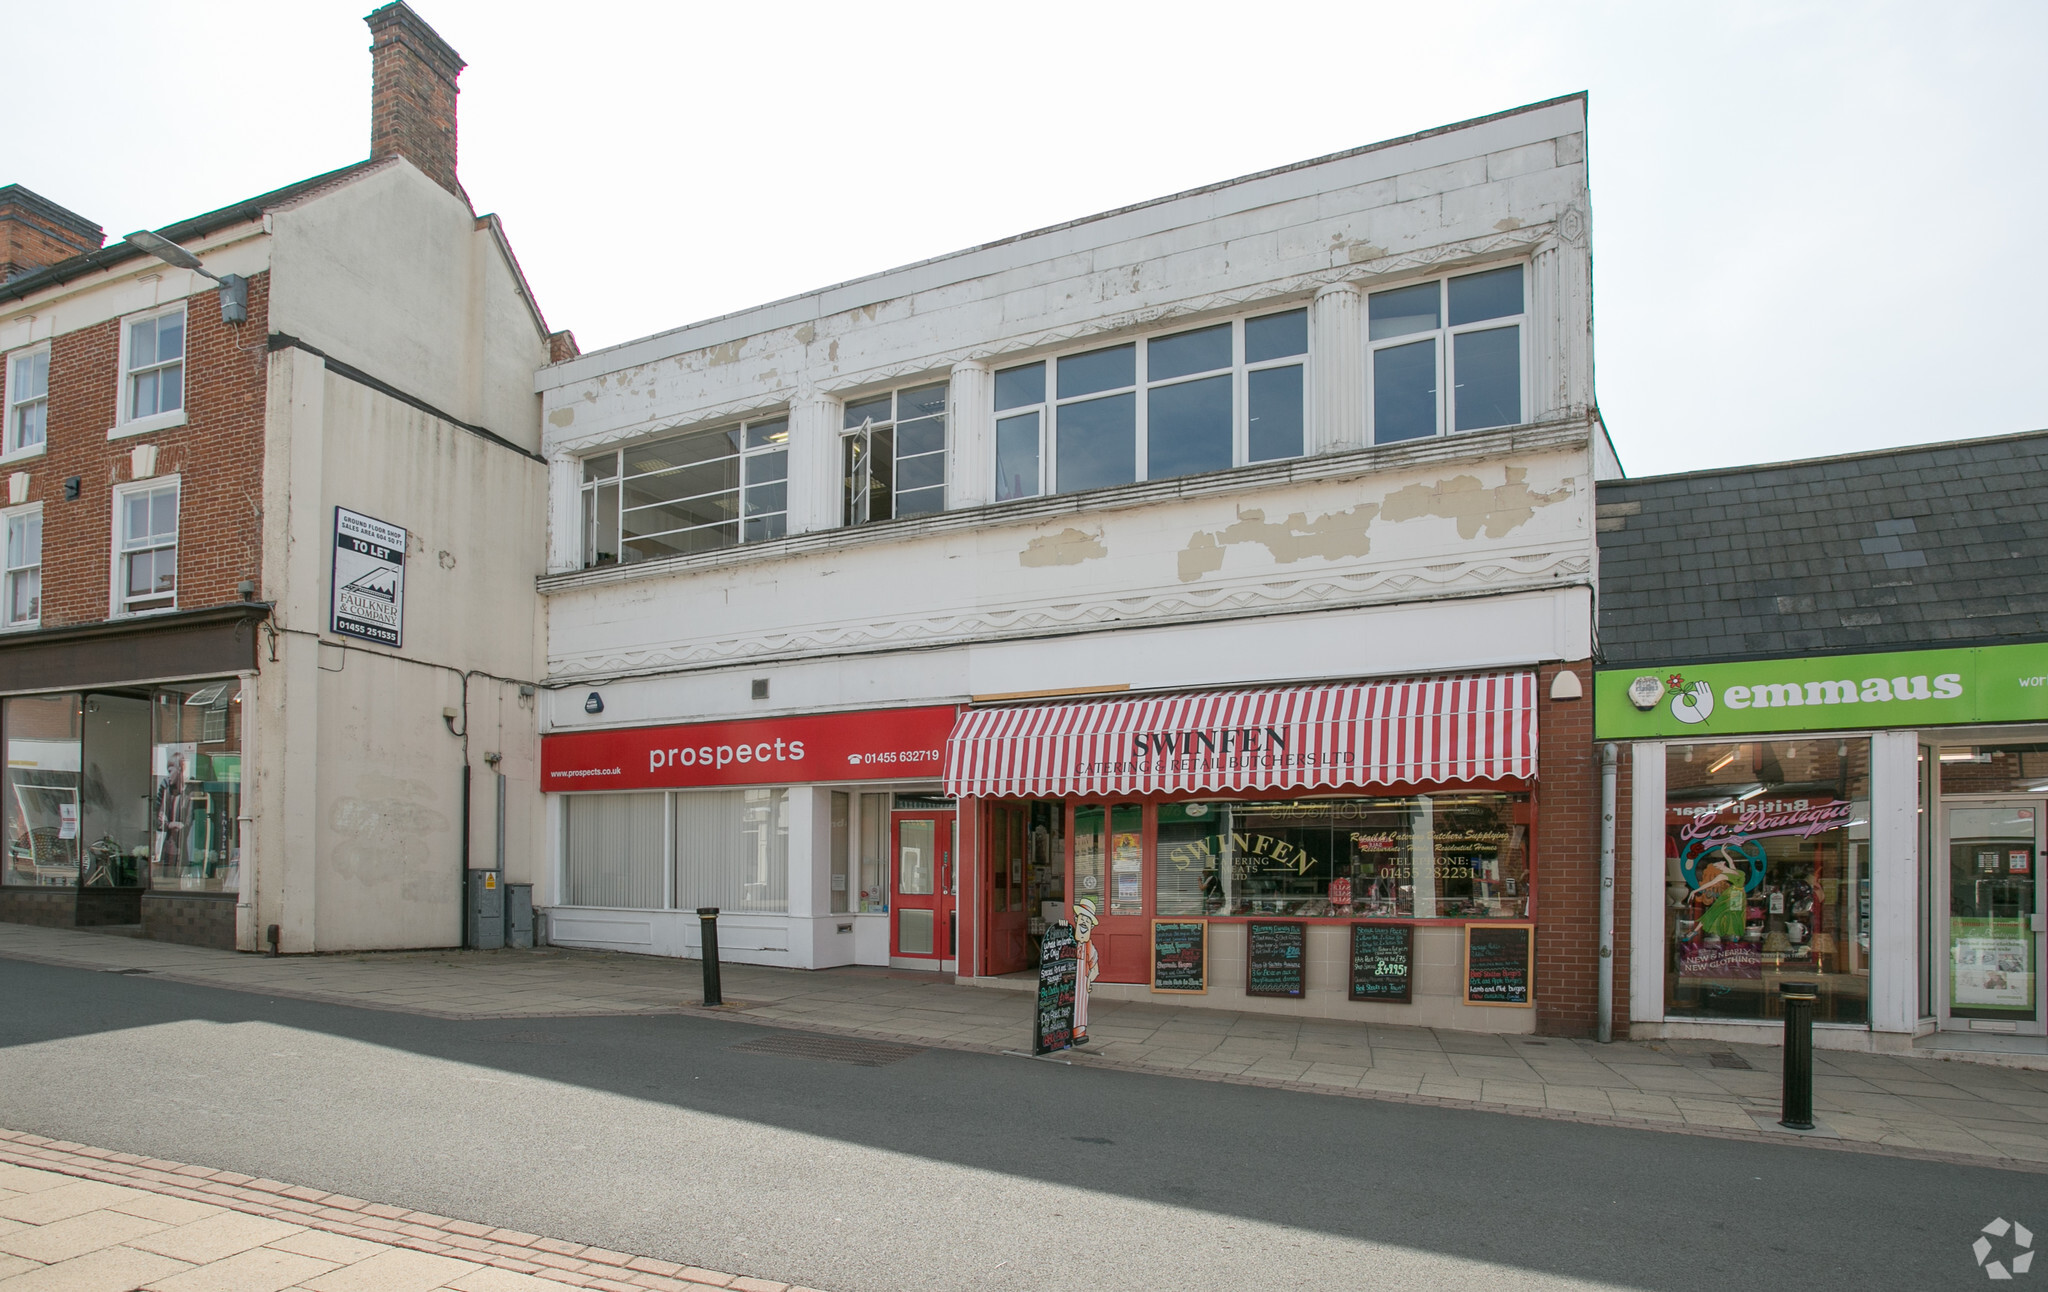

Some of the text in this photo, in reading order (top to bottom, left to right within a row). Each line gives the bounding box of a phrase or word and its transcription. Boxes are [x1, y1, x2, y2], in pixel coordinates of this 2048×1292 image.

[342, 522, 360, 532] SALES
[360, 528, 375, 537] AREA
[343, 516, 402, 538] GROUND FLOOR SHOP
[352, 539, 390, 560] TO LET
[340, 592, 398, 616] FAULKNER
[340, 603, 348, 612] &
[350, 606, 396, 624] COMPANY
[339, 620, 366, 634] 01455
[366, 628, 396, 640] 251535
[2018, 674, 2048, 688] wor
[1724, 674, 1963, 710] emmaus
[1132, 726, 1288, 758] SWINFEN
[650, 737, 806, 772] prospects
[864, 749, 939, 764] 01455 632719
[1075, 750, 1356, 775] CATERING & RETAIL BUTCHERS LTD
[550, 766, 622, 778] www.prospects.co.uk
[1680, 803, 1855, 841] La Boutique
[1350, 832, 1378, 842] Retail
[1426, 830, 1463, 840] Butchers
[1465, 829, 1510, 842] Supplying
[1170, 832, 1318, 876] SWINFEN
[1473, 843, 1497, 851] Homes
[1213, 856, 1270, 866] CATERING
[1388, 856, 1469, 866] TELEPHONE:
[1222, 866, 1258, 874] MEATS
[1380, 866, 1476, 879] 01455 282231
[1686, 955, 1709, 964] NEW
[1718, 948, 1752, 958] NEARLY
[1709, 956, 1756, 968] CLOTHING
